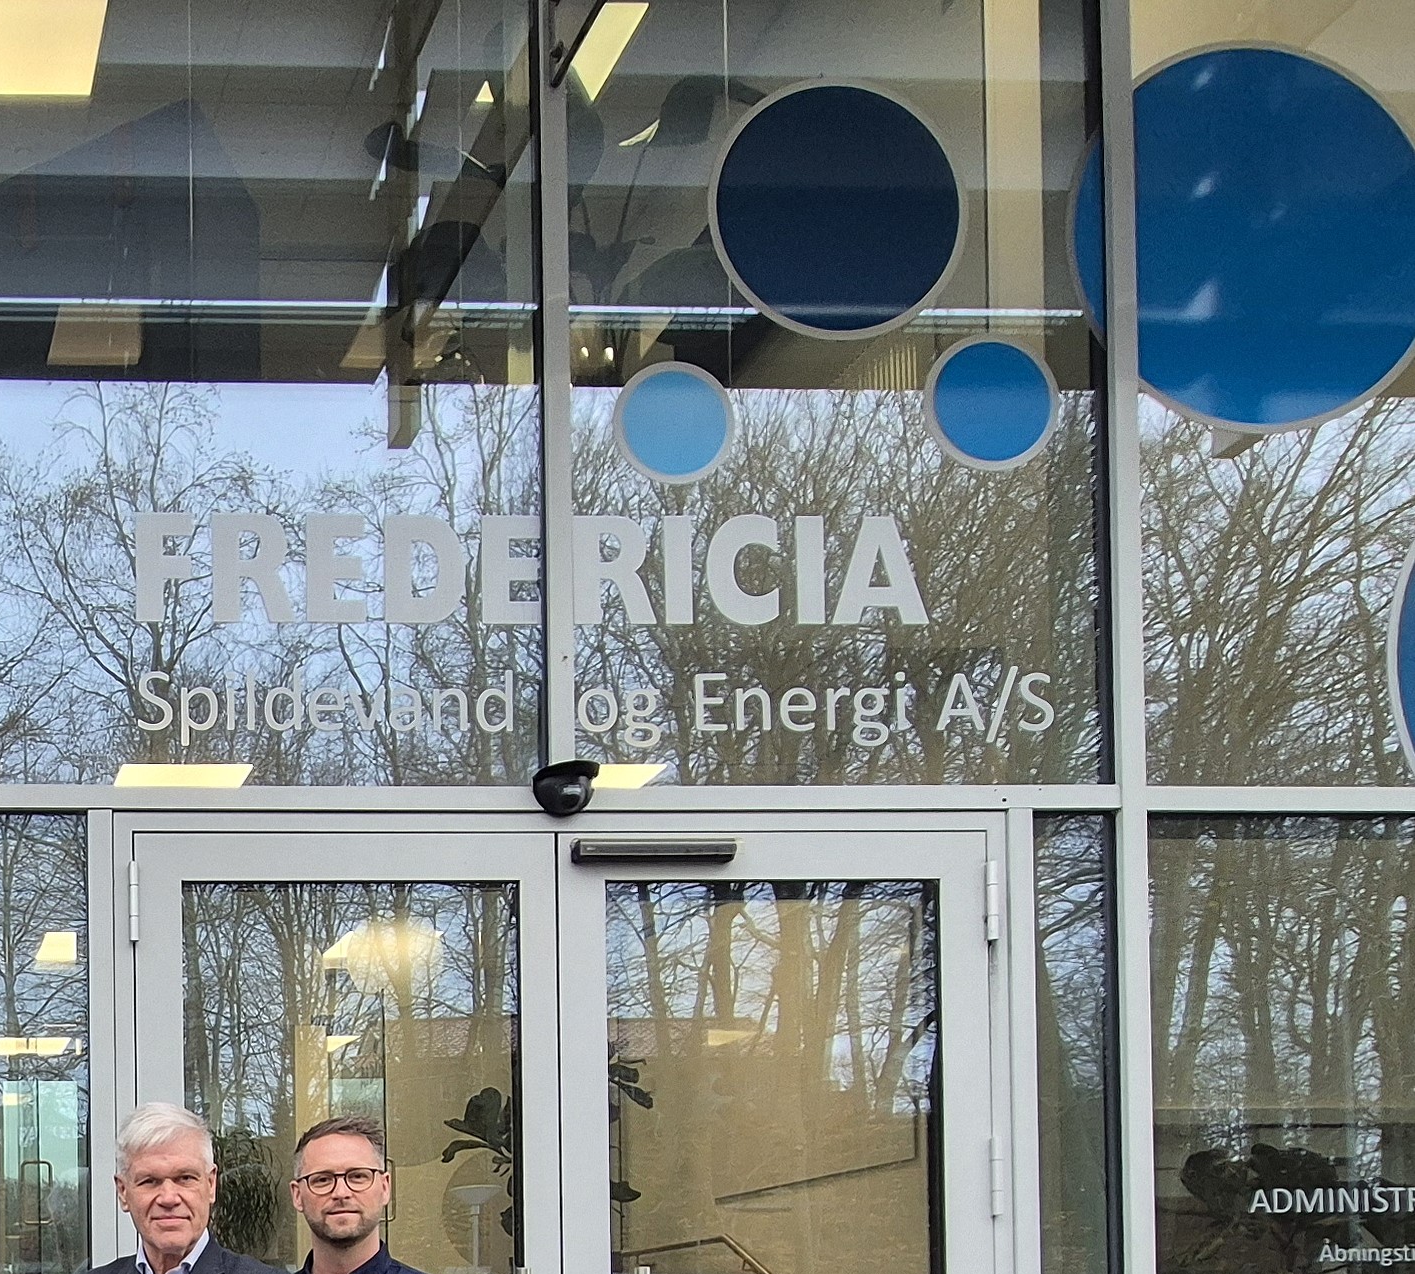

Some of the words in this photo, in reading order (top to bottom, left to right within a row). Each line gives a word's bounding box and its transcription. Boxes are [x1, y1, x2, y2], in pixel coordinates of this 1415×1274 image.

[135, 511, 929, 626] FREDERICIA
[137, 668, 514, 747] Spildevand
[577, 686, 662, 748] og
[693, 672, 911, 747] Energi
[936, 665, 1055, 743] A/S
